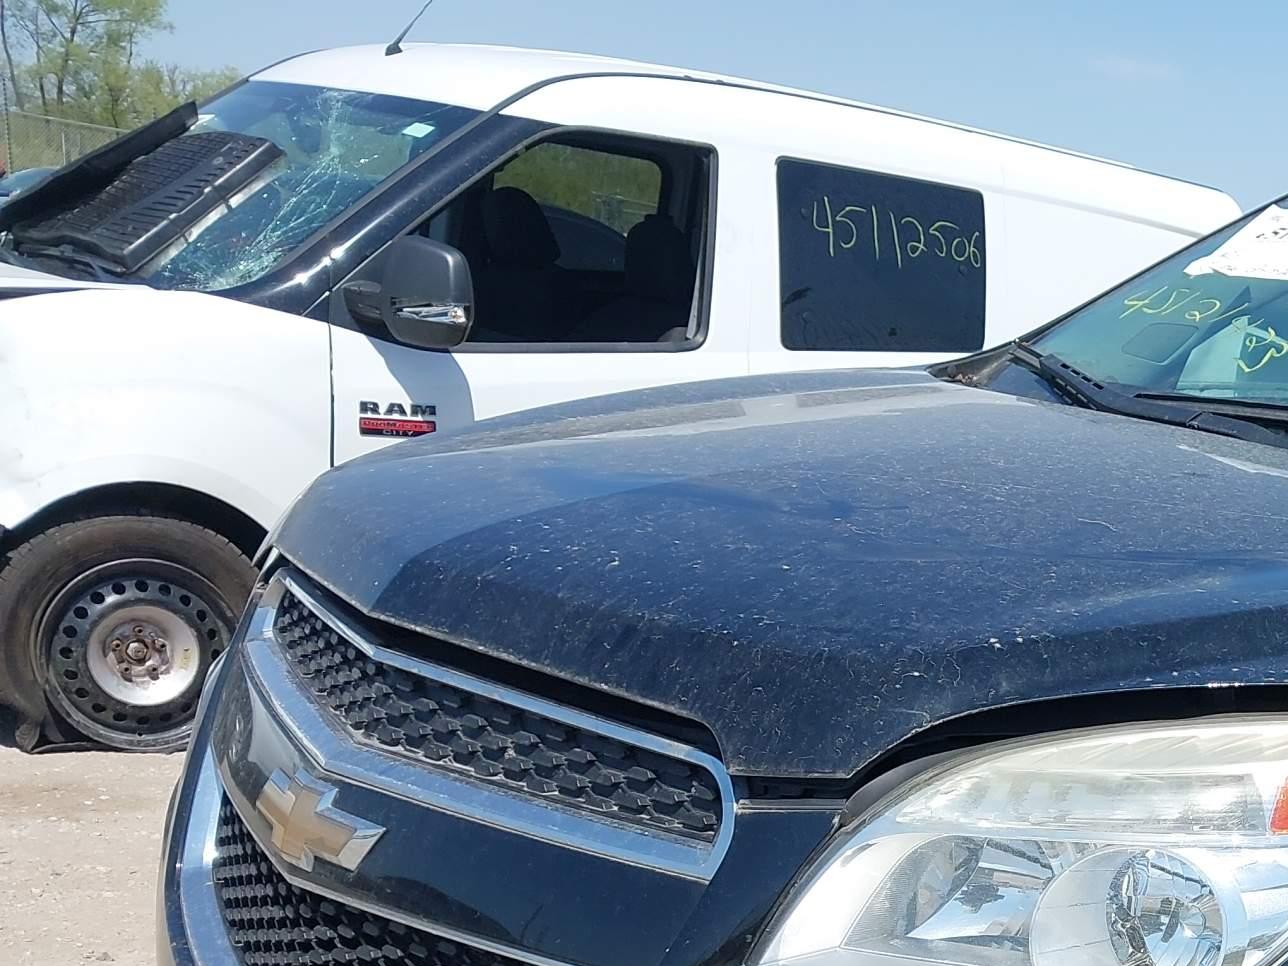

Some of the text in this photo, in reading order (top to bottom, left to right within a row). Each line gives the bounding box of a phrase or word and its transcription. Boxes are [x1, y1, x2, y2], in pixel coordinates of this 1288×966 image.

[812, 196, 981, 269] 45112506
[360, 401, 436, 416] RAM
[383, 429, 414, 437] CITY
